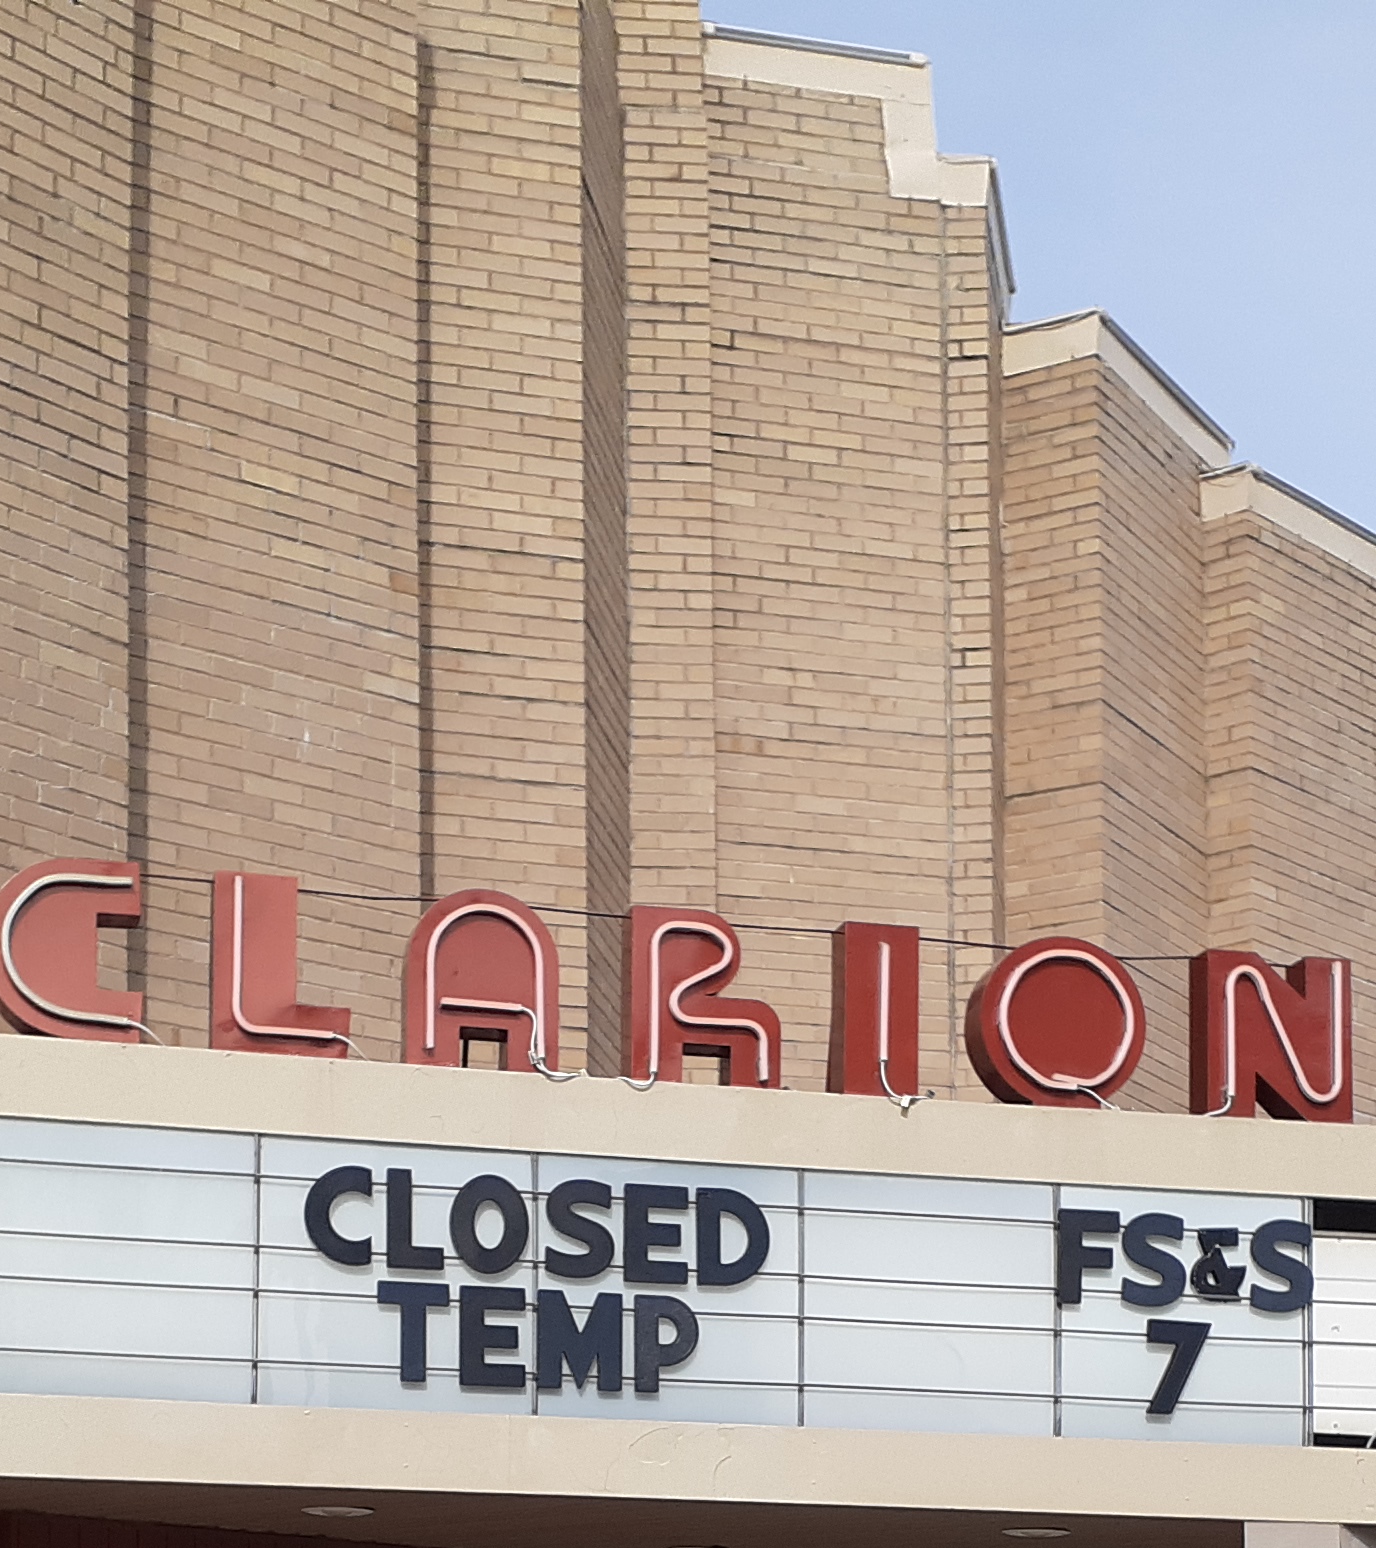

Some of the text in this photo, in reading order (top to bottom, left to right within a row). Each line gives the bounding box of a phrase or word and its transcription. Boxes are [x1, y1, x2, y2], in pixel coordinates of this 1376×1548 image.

[304, 1165, 770, 1286] CLOSED
[377, 1280, 699, 1393] TEMP
[1146, 1318, 1212, 1415] 7
